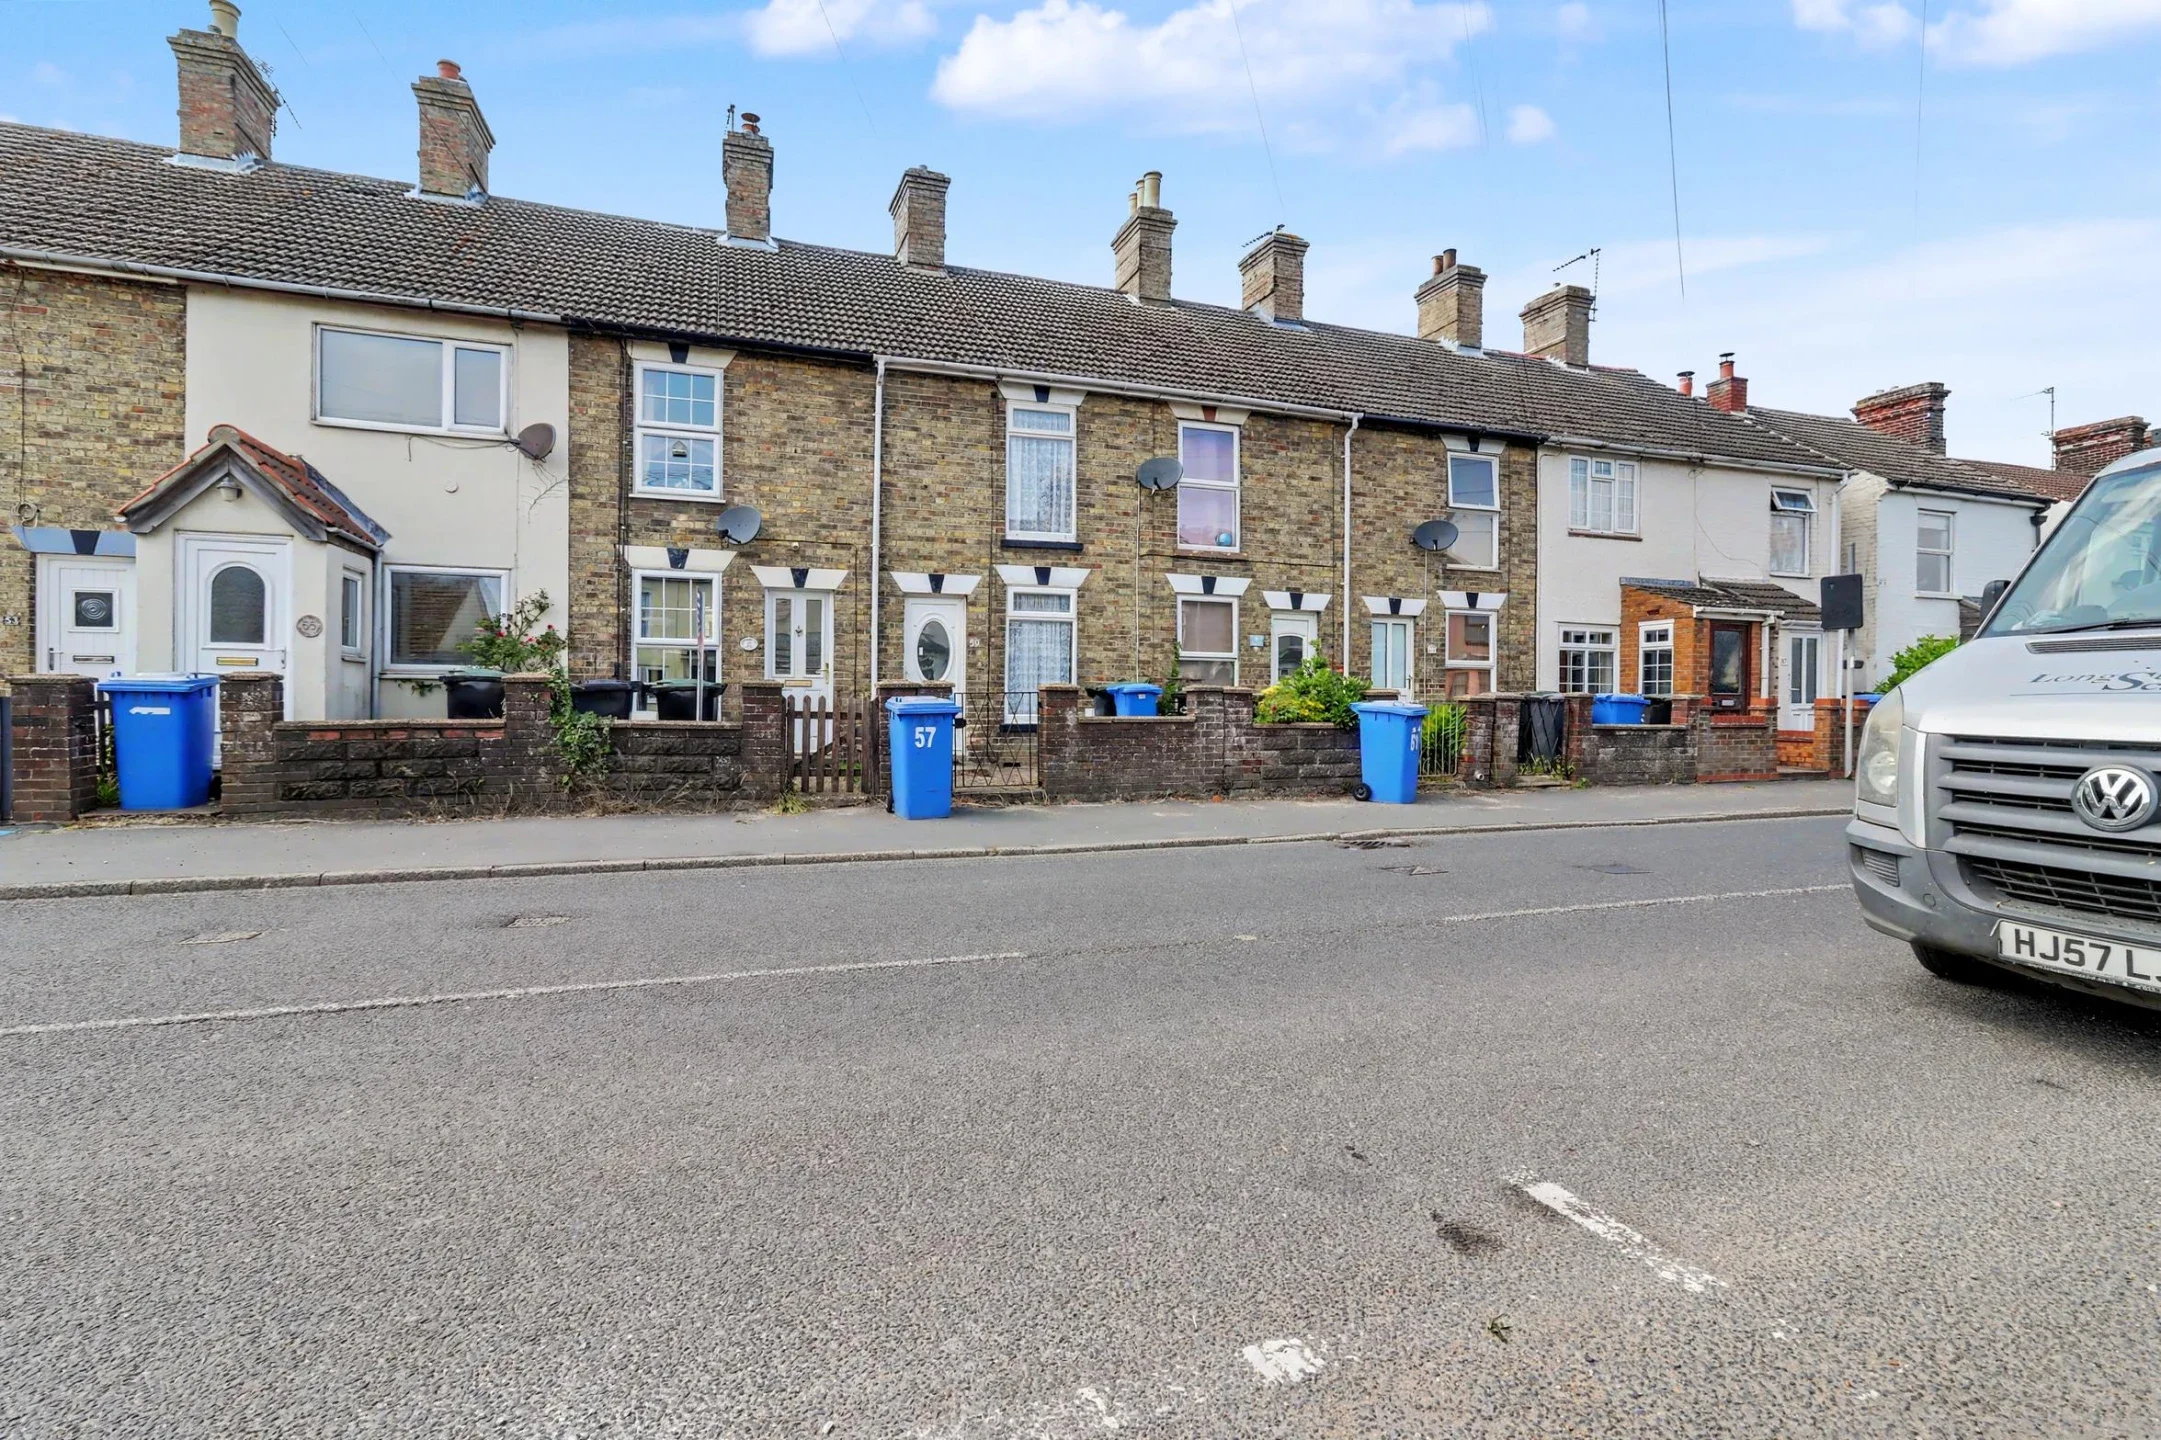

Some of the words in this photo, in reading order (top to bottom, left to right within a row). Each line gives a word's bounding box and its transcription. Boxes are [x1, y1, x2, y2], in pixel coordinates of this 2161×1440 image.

[914, 726, 937, 748] 57
[2077, 768, 2151, 827] VW
[2014, 928, 2112, 972] HJ57
[2125, 949, 2161, 983] L
